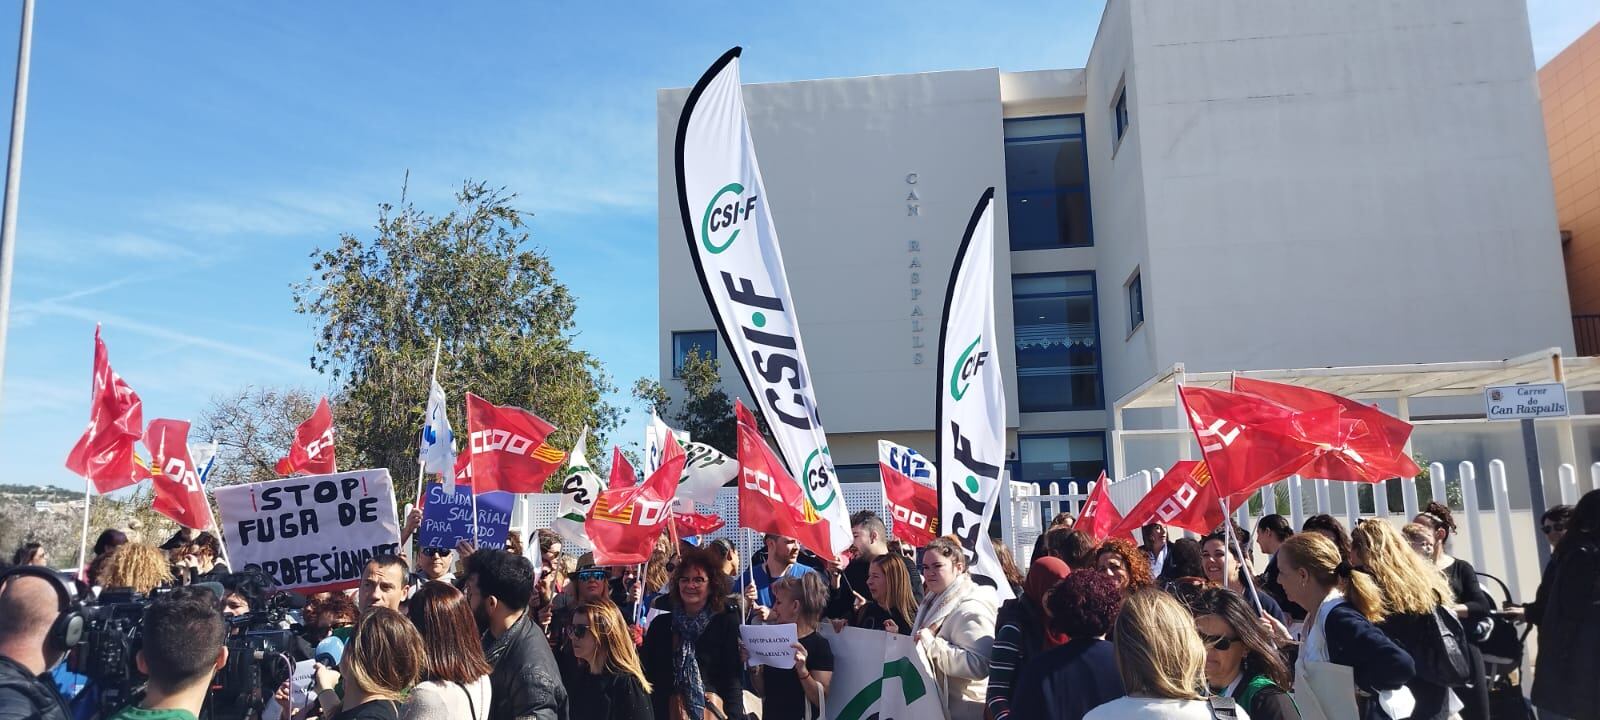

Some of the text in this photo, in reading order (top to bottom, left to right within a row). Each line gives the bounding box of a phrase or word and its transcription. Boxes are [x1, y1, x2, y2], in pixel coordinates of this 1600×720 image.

[905, 173, 925, 365] CAN RASPALLS
[1517, 387, 1547, 396] Carrer
[1491, 402, 1565, 415] Can Raspalls
[238, 497, 378, 546] FUGA DE
[424, 519, 453, 532] PARA
[429, 536, 444, 548] EL
